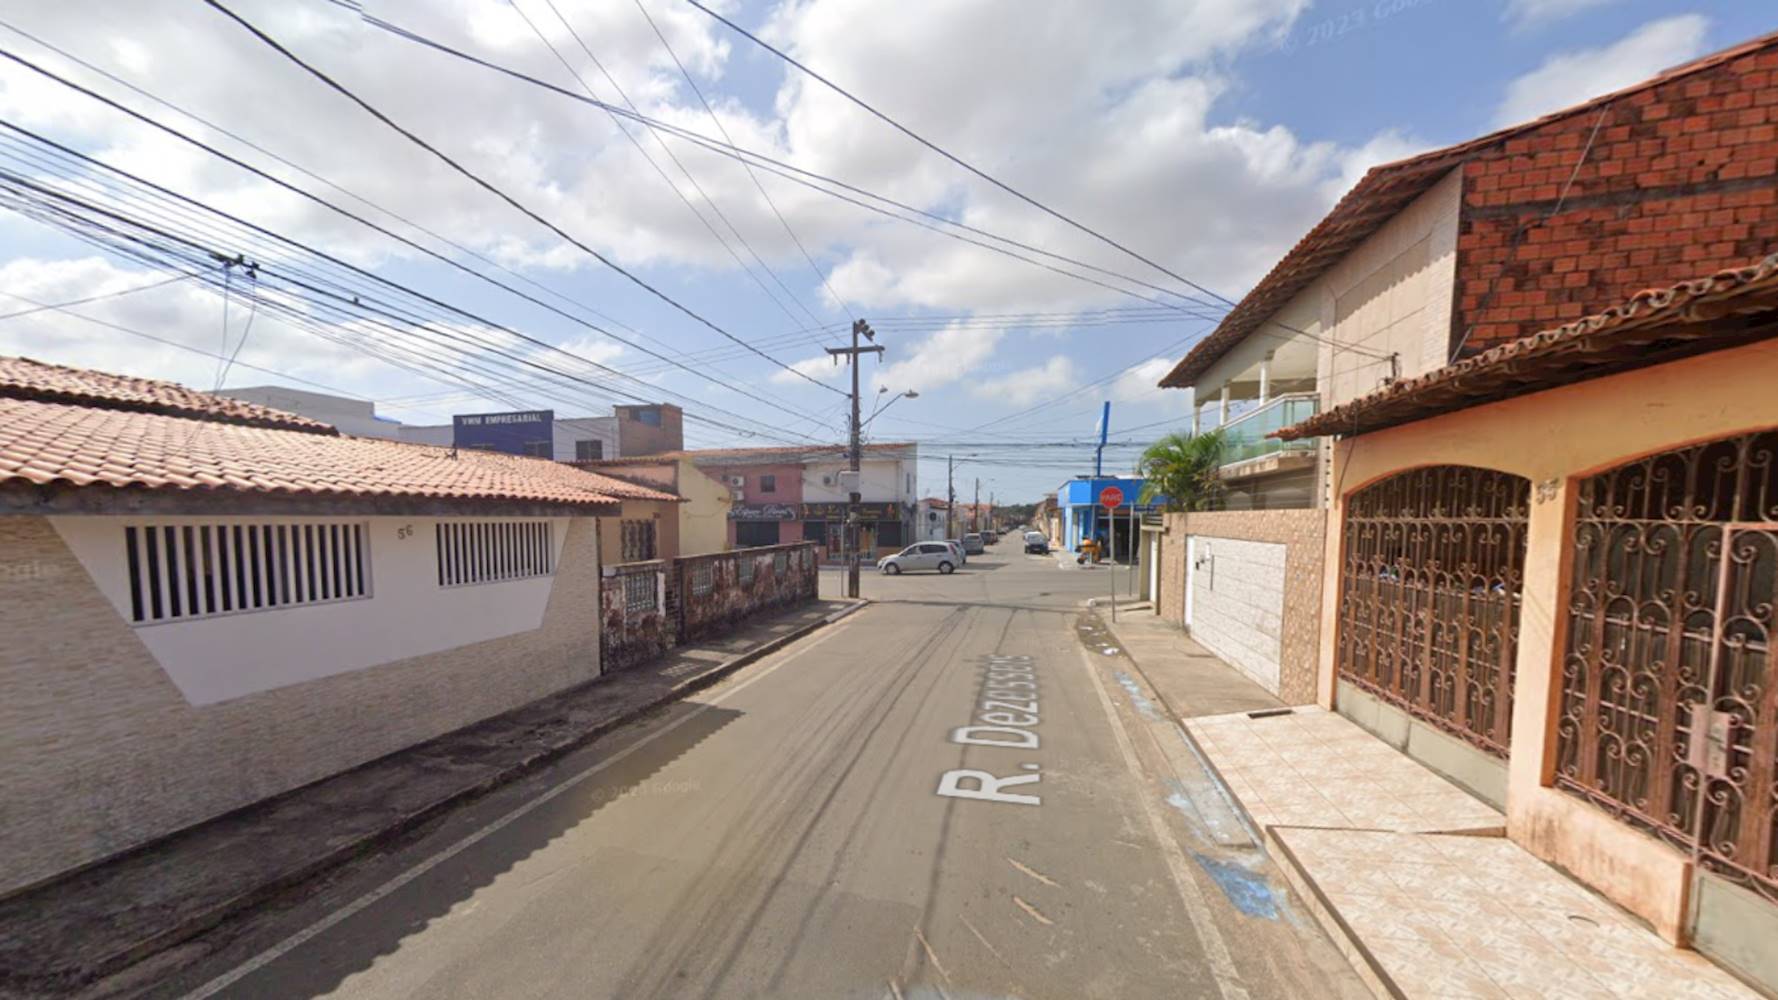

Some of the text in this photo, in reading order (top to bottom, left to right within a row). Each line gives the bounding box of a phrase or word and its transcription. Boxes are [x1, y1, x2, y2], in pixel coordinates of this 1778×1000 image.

[485, 413, 541, 424] EMPRESARIAL
[1101, 493, 1121, 502] PARE
[397, 524, 414, 540] 56
